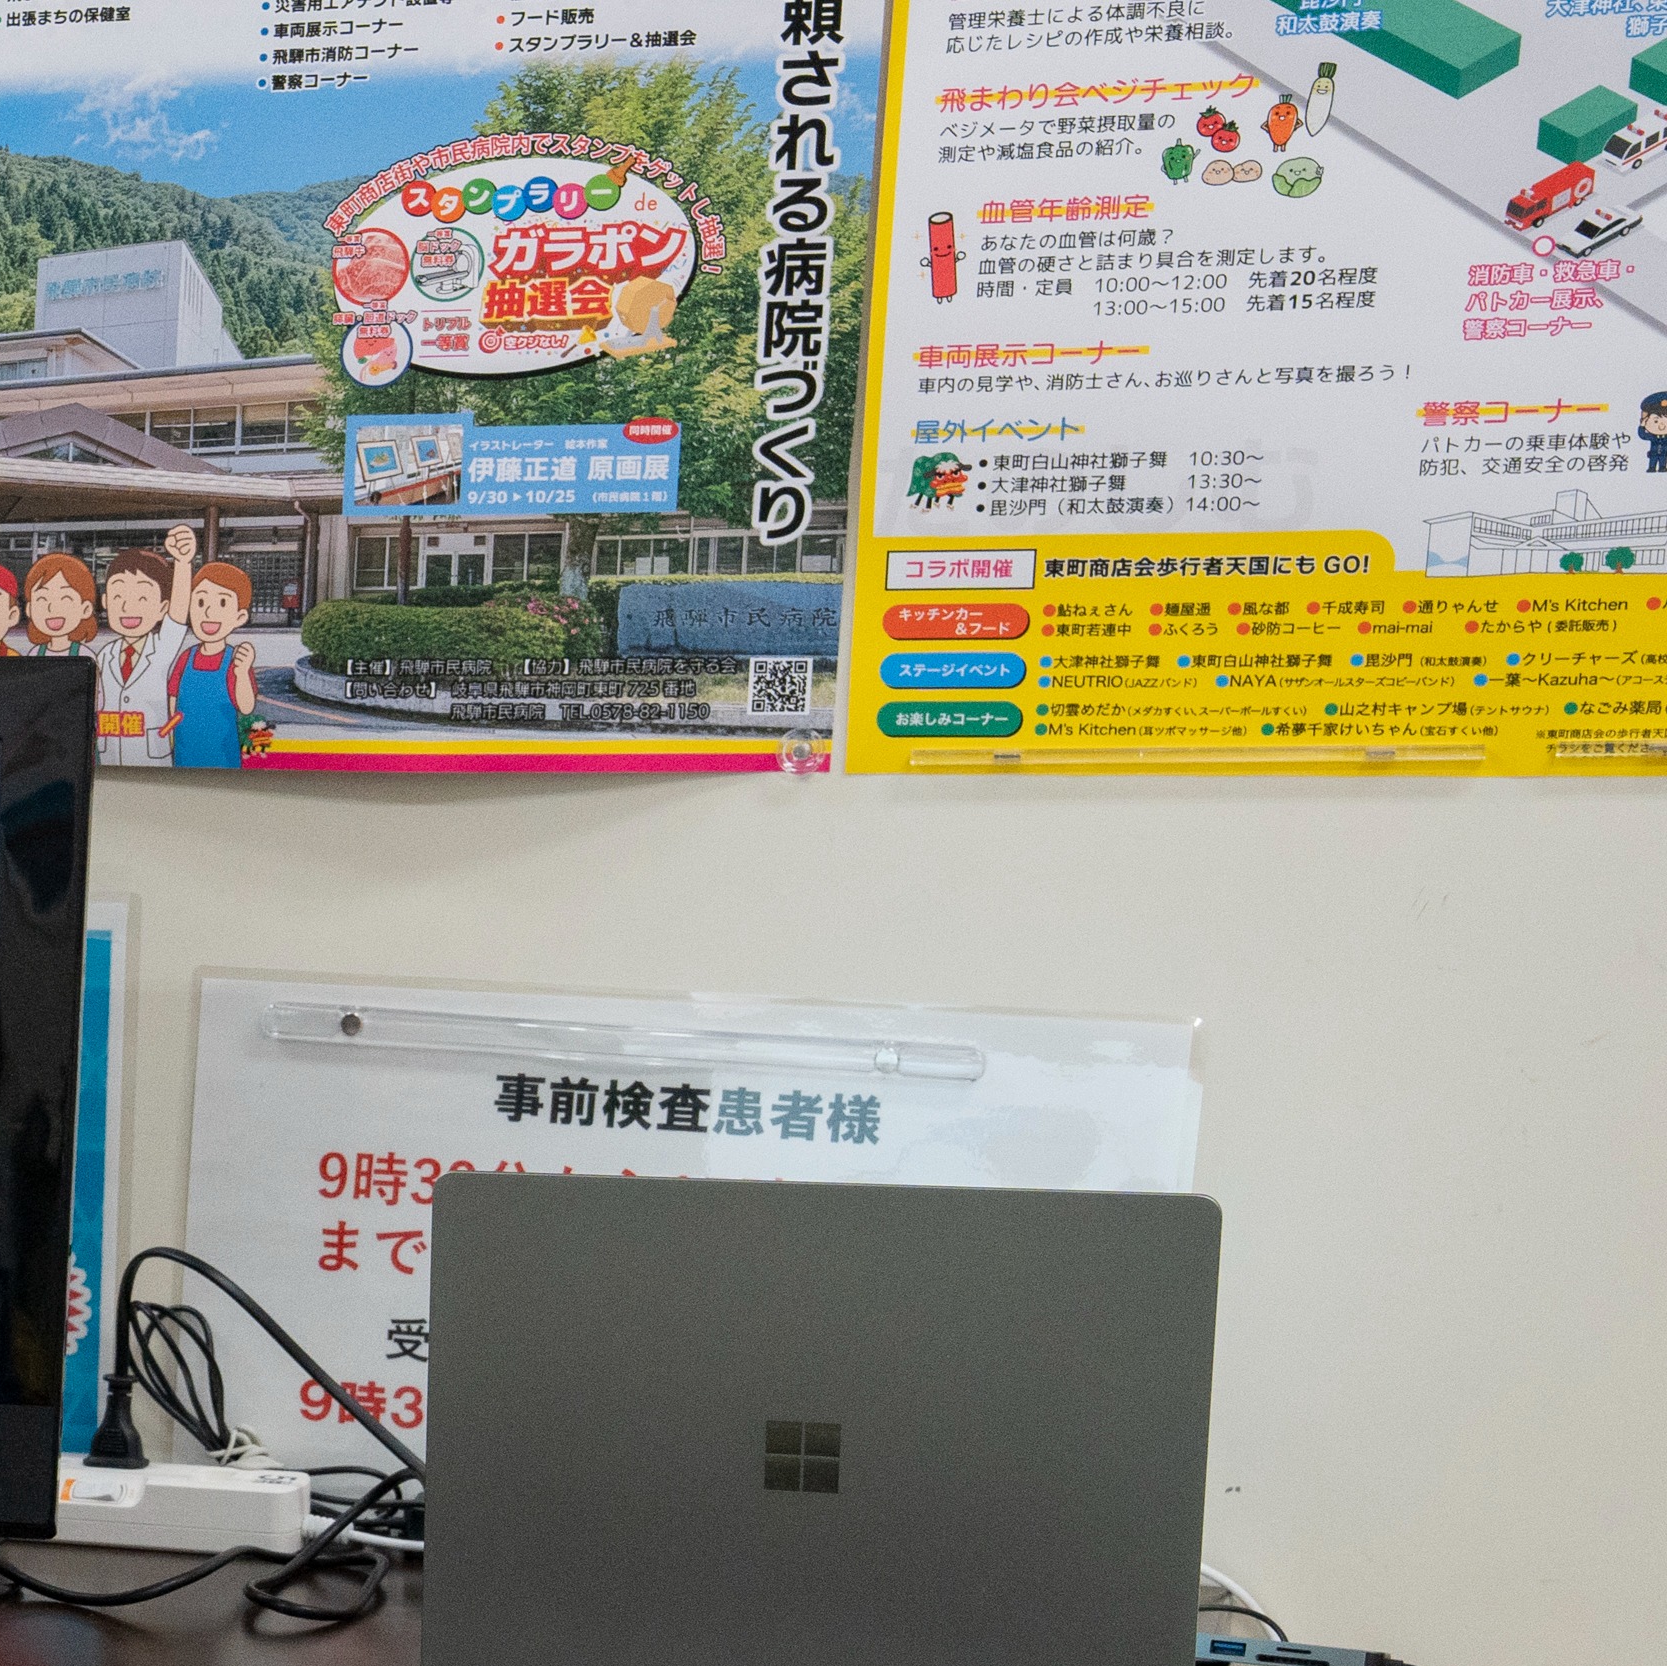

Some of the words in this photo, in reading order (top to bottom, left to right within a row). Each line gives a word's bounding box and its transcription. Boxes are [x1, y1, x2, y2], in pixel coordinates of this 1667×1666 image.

[6, 5, 130, 27] 出張まちの保健室
[511, 8, 594, 26] フード販売
[948, 0, 1205, 30] 管理栄養士による体調不良に
[1276, 11, 1382, 35] 和太鼓演奏
[273, 19, 403, 39] 車両展示コーナー
[946, 21, 1236, 55] 応じたレシピの作成や栄養相談。
[509, 30, 696, 52] スタンプラリー＆抽選会
[272, 44, 419, 64] 飛騨市消防コーナー
[270, 73, 368, 91] 警察コーナー
[940, 72, 1256, 113] 飛まわり会ベジチェック
[939, 111, 1176, 140] ベジメータで野菜摂取量の
[938, 139, 1145, 164] 測定や減塩食品の紹介。
[408, 181, 615, 219] スタンプラリー
[634, 195, 658, 212] de
[981, 195, 1150, 225] 血管年齢測定
[494, 225, 687, 273] ガラポン
[980, 229, 1175, 252] あなたの血管は何歳？
[978, 245, 1328, 276] 血管の硬さと詰まり具合を測定します。
[976, 277, 1073, 298] 時間・定員
[1248, 266, 1379, 291] 先着20名程度
[484, 278, 615, 320] 抽選会
[1246, 291, 1377, 313] 先着15名程度
[423, 315, 471, 331] トリプル
[1463, 318, 1593, 341] 警察コーナー
[919, 340, 1140, 369] 車両展示コーナー
[1423, 398, 1601, 427] 警察コーナー
[628, 424, 674, 438] 同時開催
[915, 417, 1080, 444] 屋外イベント
[469, 438, 554, 452] イラストレーター
[565, 438, 607, 450] 絵本作家
[1422, 432, 1632, 454] パトカーの乗車体験や
[469, 456, 577, 482] 伊藤正道
[588, 456, 669, 482] 原画展
[1419, 453, 1629, 477] 防犯、交通安全の啓発
[469, 489, 507, 504] 9/30
[526, 489, 575, 504] 10/25
[906, 559, 1013, 579] コラボ開催
[1044, 555, 1315, 579] 東町商店会歩行者天国にも
[1324, 556, 1369, 574] GO!
[899, 608, 983, 621] キッチンカー
[1565, 599, 1628, 612] Kitchen
[1163, 623, 1219, 637] ふくろう
[1373, 621, 1433, 635] mai-mai
[899, 663, 1010, 677] ステージイベント
[628, 682, 659, 697] 725
[896, 712, 1008, 726] お楽しみコーナー
[494, 1072, 881, 1147] 事前検査患者様
